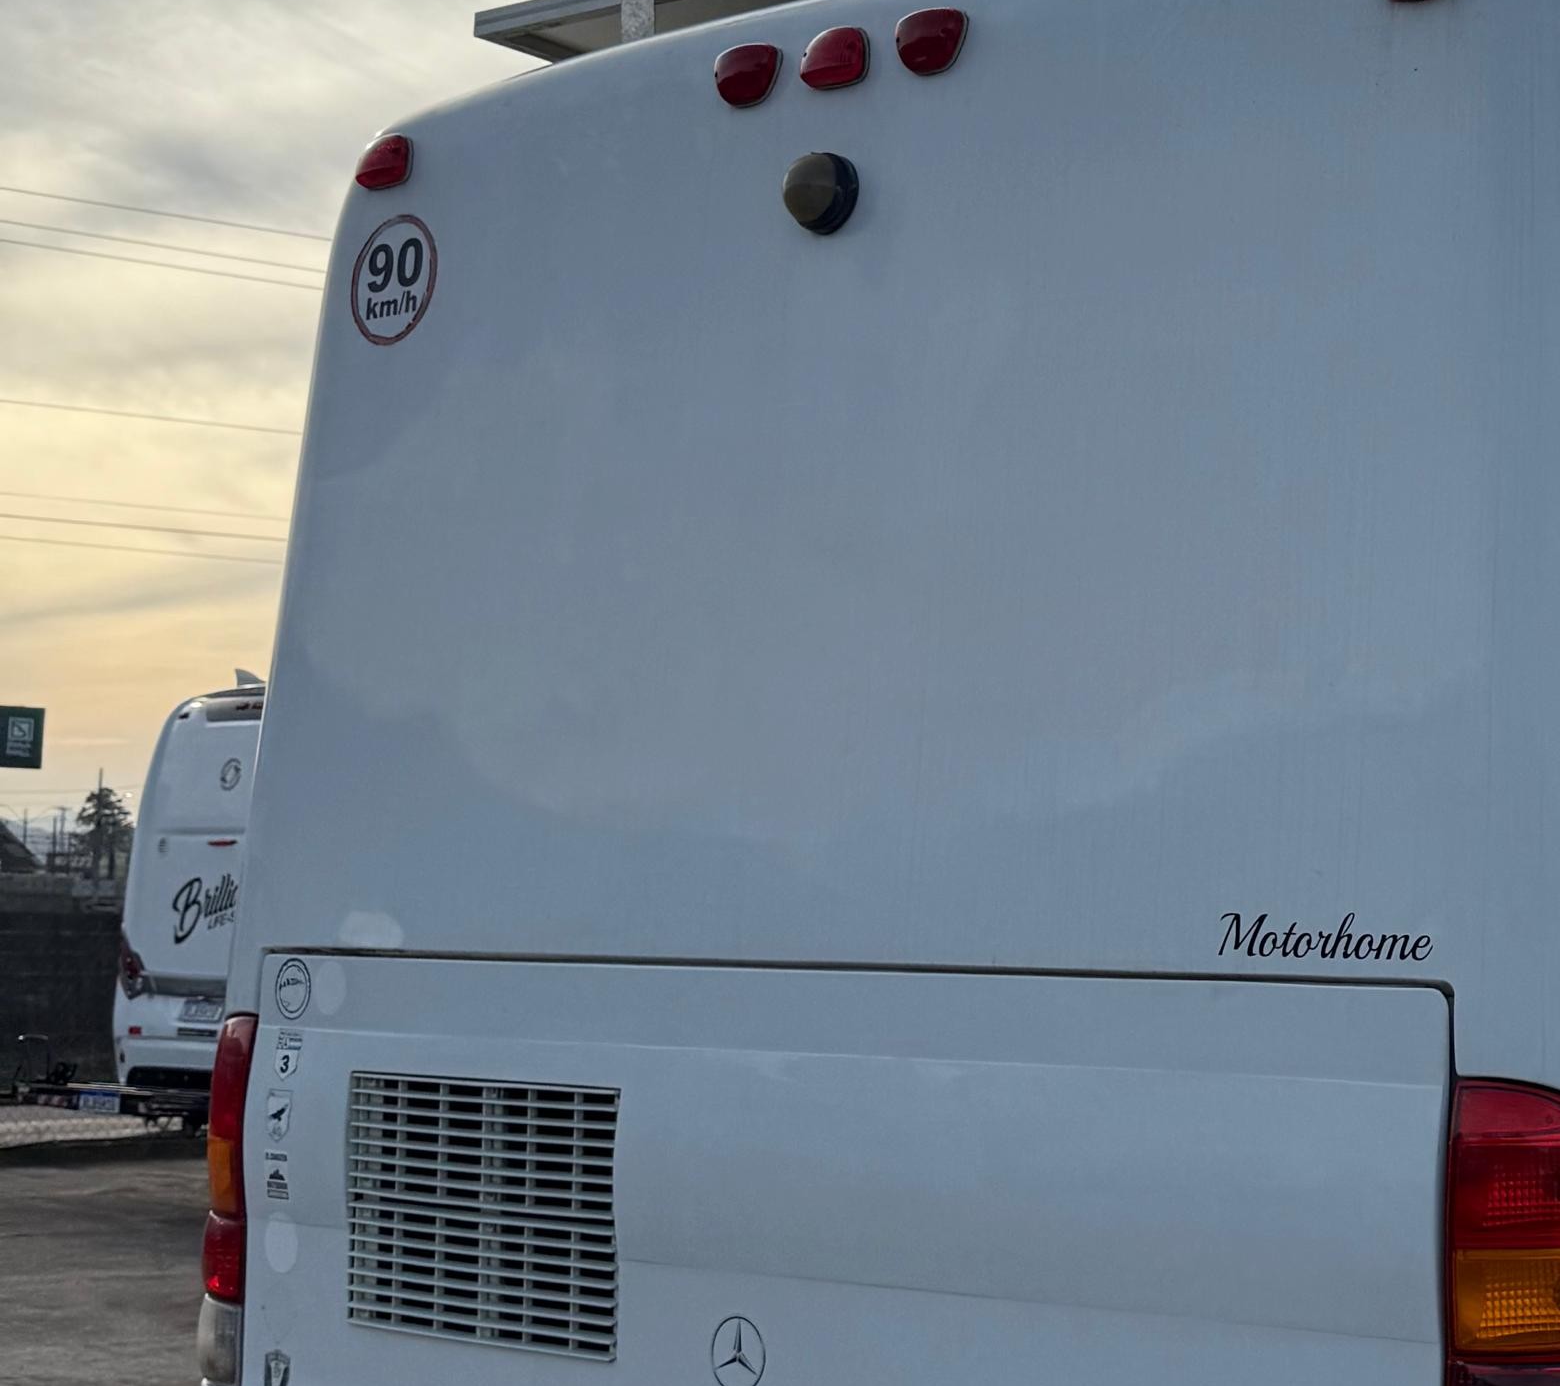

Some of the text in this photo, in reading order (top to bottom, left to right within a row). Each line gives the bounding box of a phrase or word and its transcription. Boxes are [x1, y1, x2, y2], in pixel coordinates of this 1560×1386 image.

[367, 237, 424, 293] 90
[365, 290, 418, 321] km/h
[1218, 912, 1434, 961] Motorhome
[279, 1054, 290, 1074] 3
